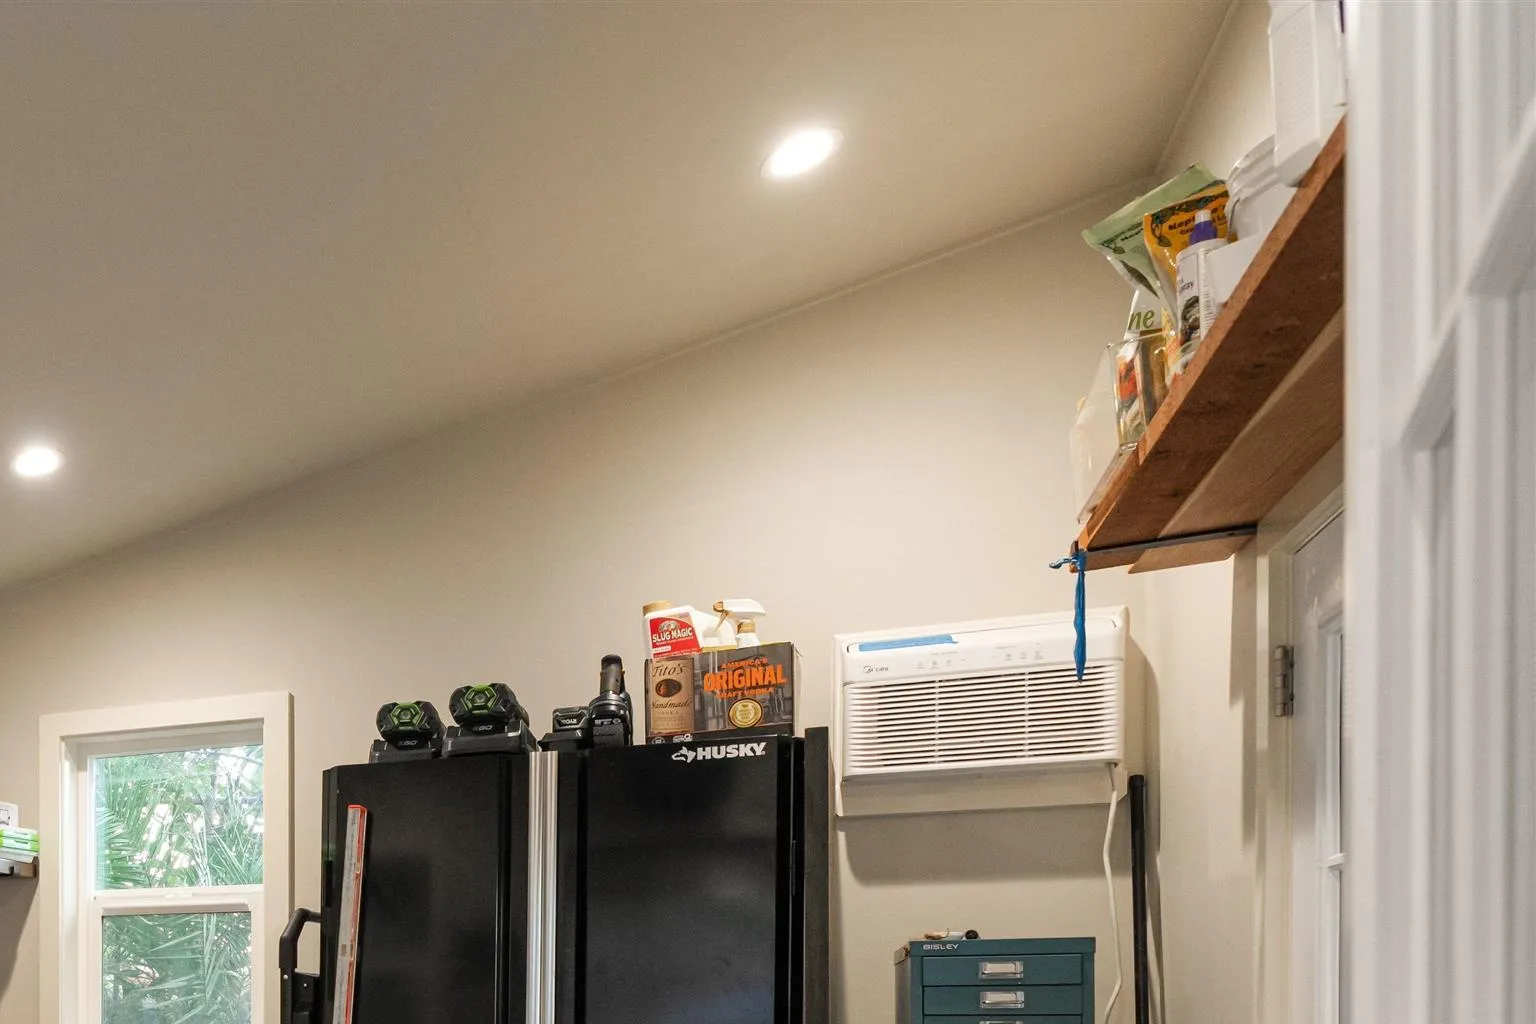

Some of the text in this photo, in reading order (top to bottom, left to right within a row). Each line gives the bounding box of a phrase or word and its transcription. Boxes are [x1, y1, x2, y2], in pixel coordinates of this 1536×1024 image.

[652, 626, 693, 643] SLUG MAGIC
[653, 664, 686, 677] Tito's
[720, 656, 768, 670] AMERICA'S
[703, 664, 787, 693] ORIGINAL
[696, 742, 766, 761] HUSKY
